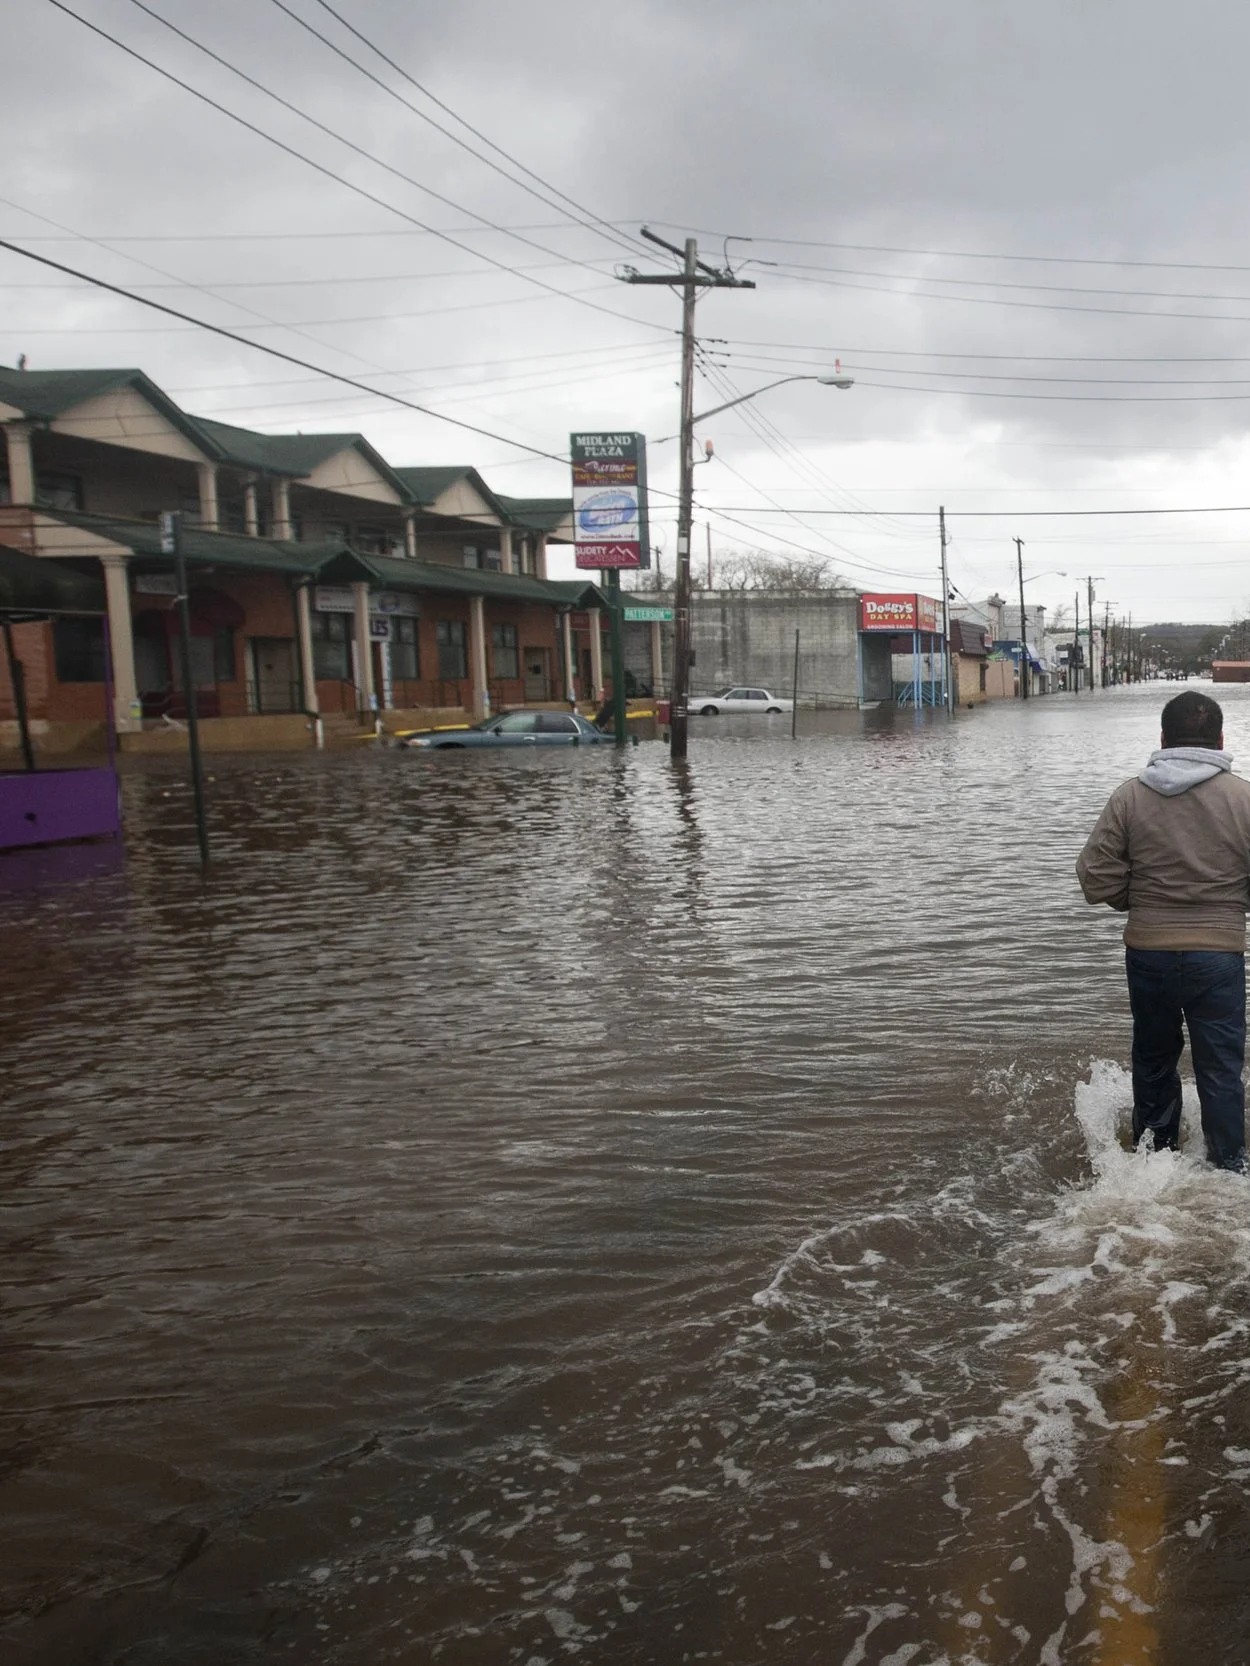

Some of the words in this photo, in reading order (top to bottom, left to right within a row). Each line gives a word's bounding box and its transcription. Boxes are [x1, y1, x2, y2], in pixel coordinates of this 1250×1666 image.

[577, 436, 631, 446] MIDLAND
[585, 446, 624, 457] PLAZA
[576, 546, 608, 555] SUDETY
[866, 602, 913, 613] Doggy's
